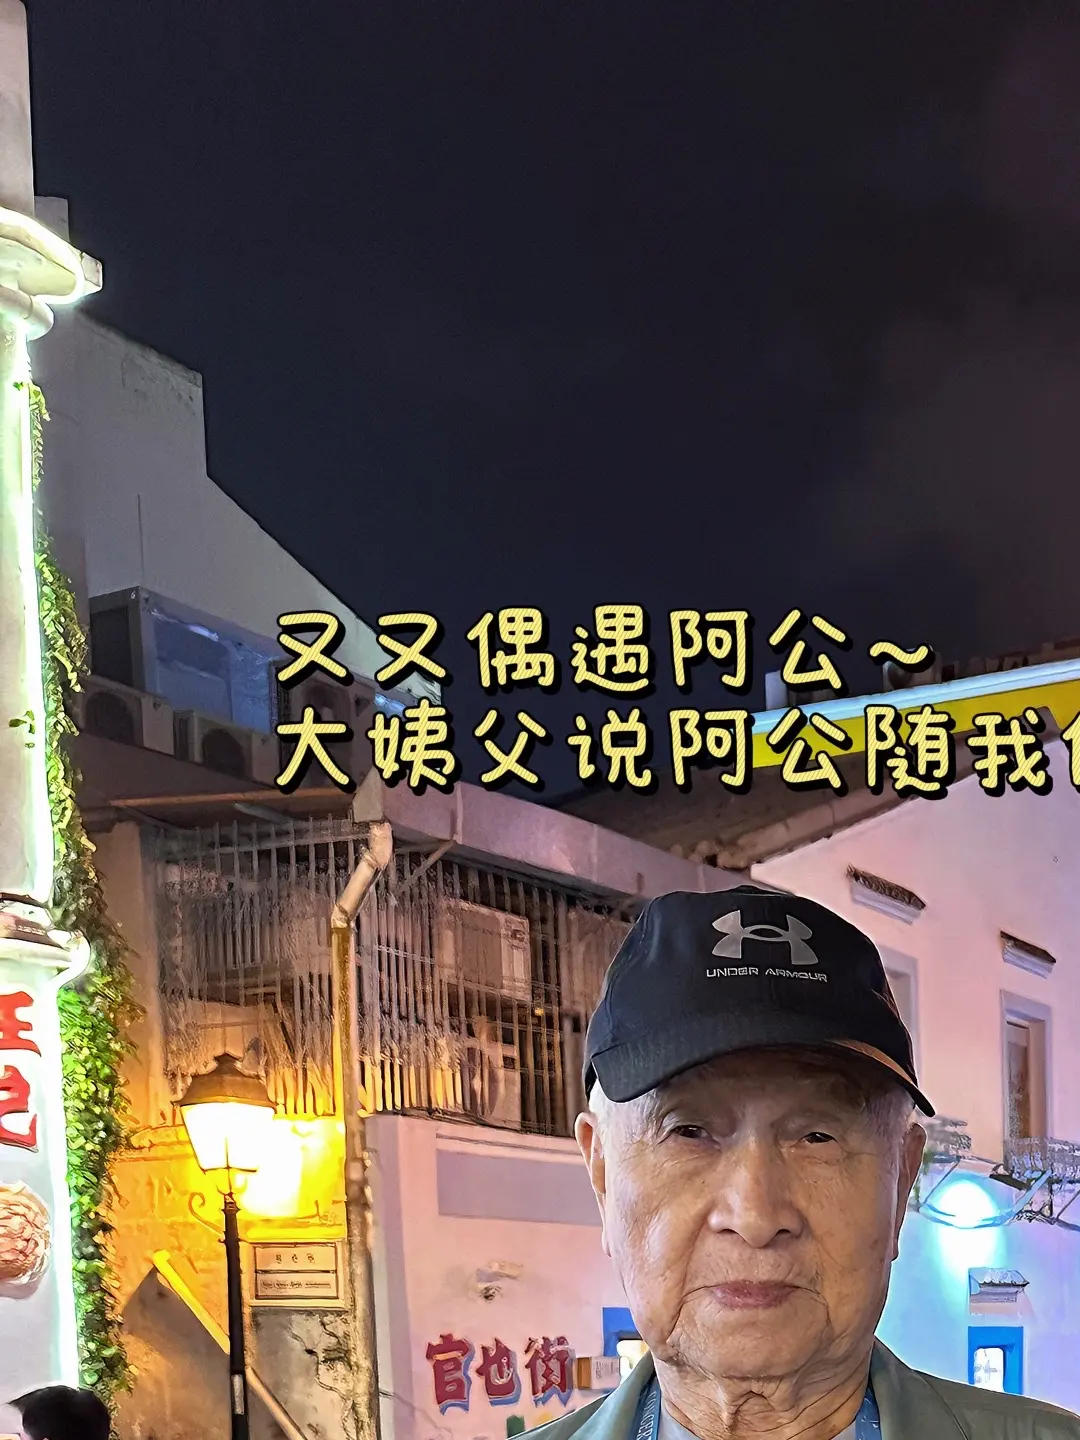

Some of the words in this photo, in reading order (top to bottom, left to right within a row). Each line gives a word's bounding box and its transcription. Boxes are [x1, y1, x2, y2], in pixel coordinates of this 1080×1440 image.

[706, 966, 759, 978] UNDER
[765, 967, 828, 983] ARMOUR
[425, 1333, 574, 1411] 官也街
